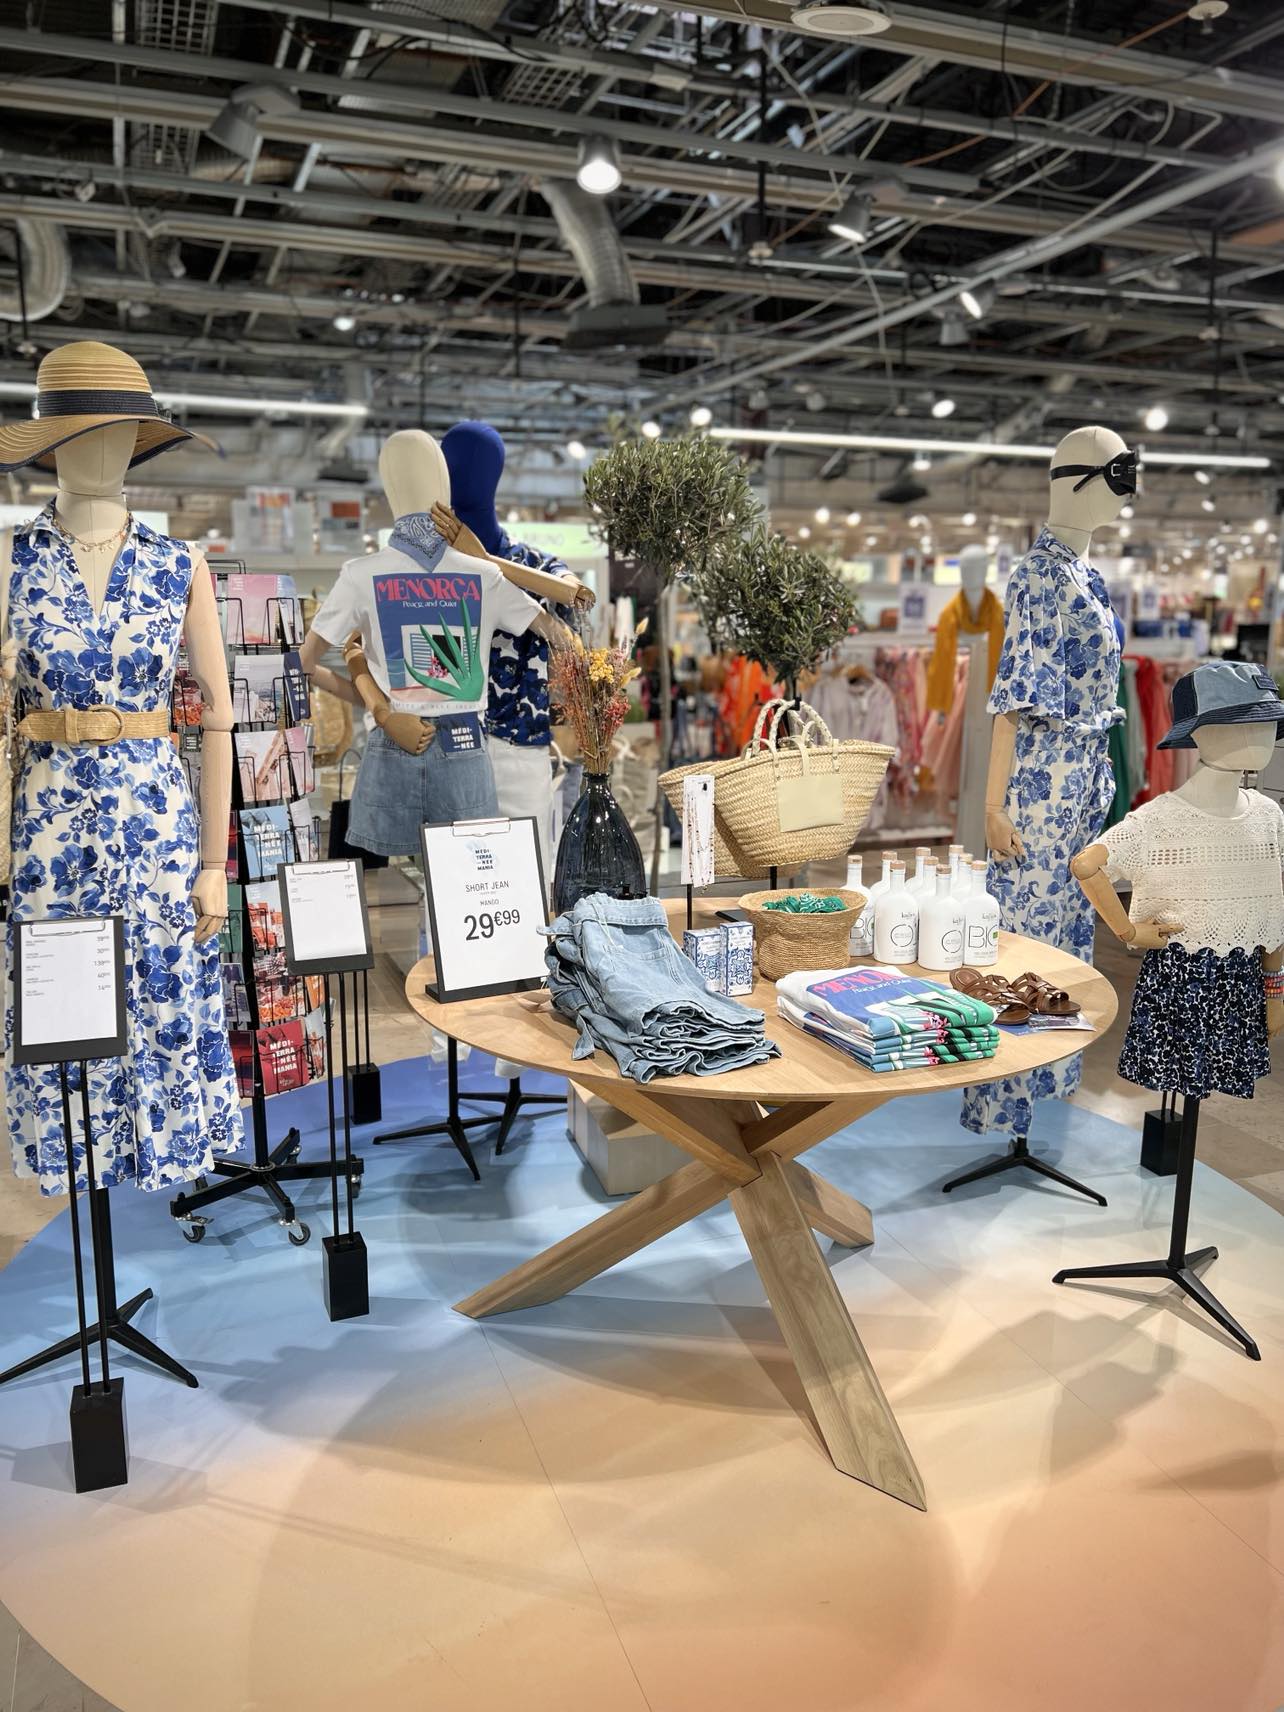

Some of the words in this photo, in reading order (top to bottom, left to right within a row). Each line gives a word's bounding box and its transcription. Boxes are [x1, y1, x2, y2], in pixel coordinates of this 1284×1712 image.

[375, 577, 481, 602] MENORCA
[425, 600, 438, 608] and
[465, 882, 489, 893] SHORT
[491, 880, 510, 890] JEAN
